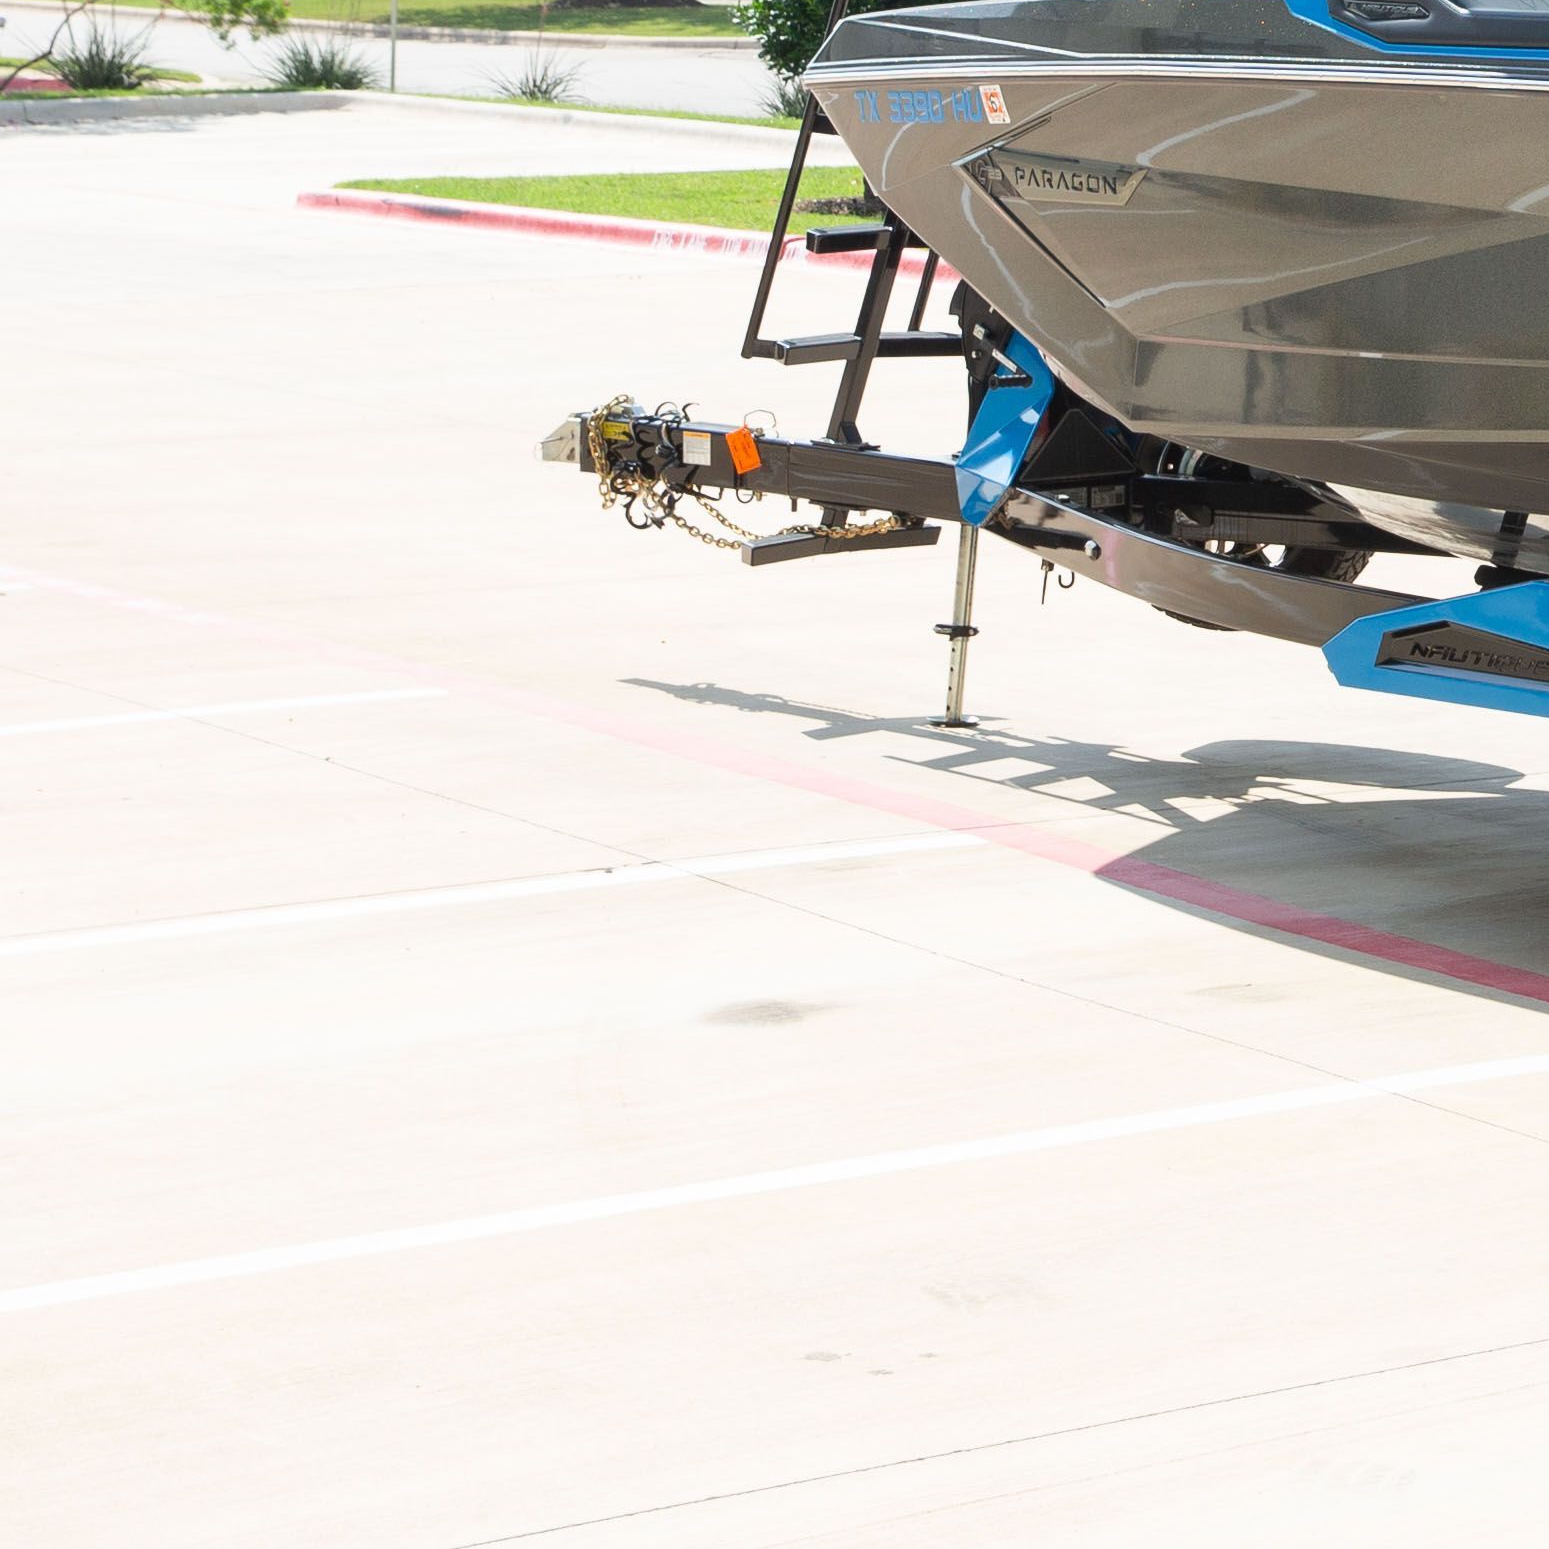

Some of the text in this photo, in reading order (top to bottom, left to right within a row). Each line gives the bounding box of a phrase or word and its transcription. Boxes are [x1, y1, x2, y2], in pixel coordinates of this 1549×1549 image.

[854, 89, 881, 123] TX
[951, 88, 983, 123] HU
[1015, 166, 1117, 195] PARAGON
